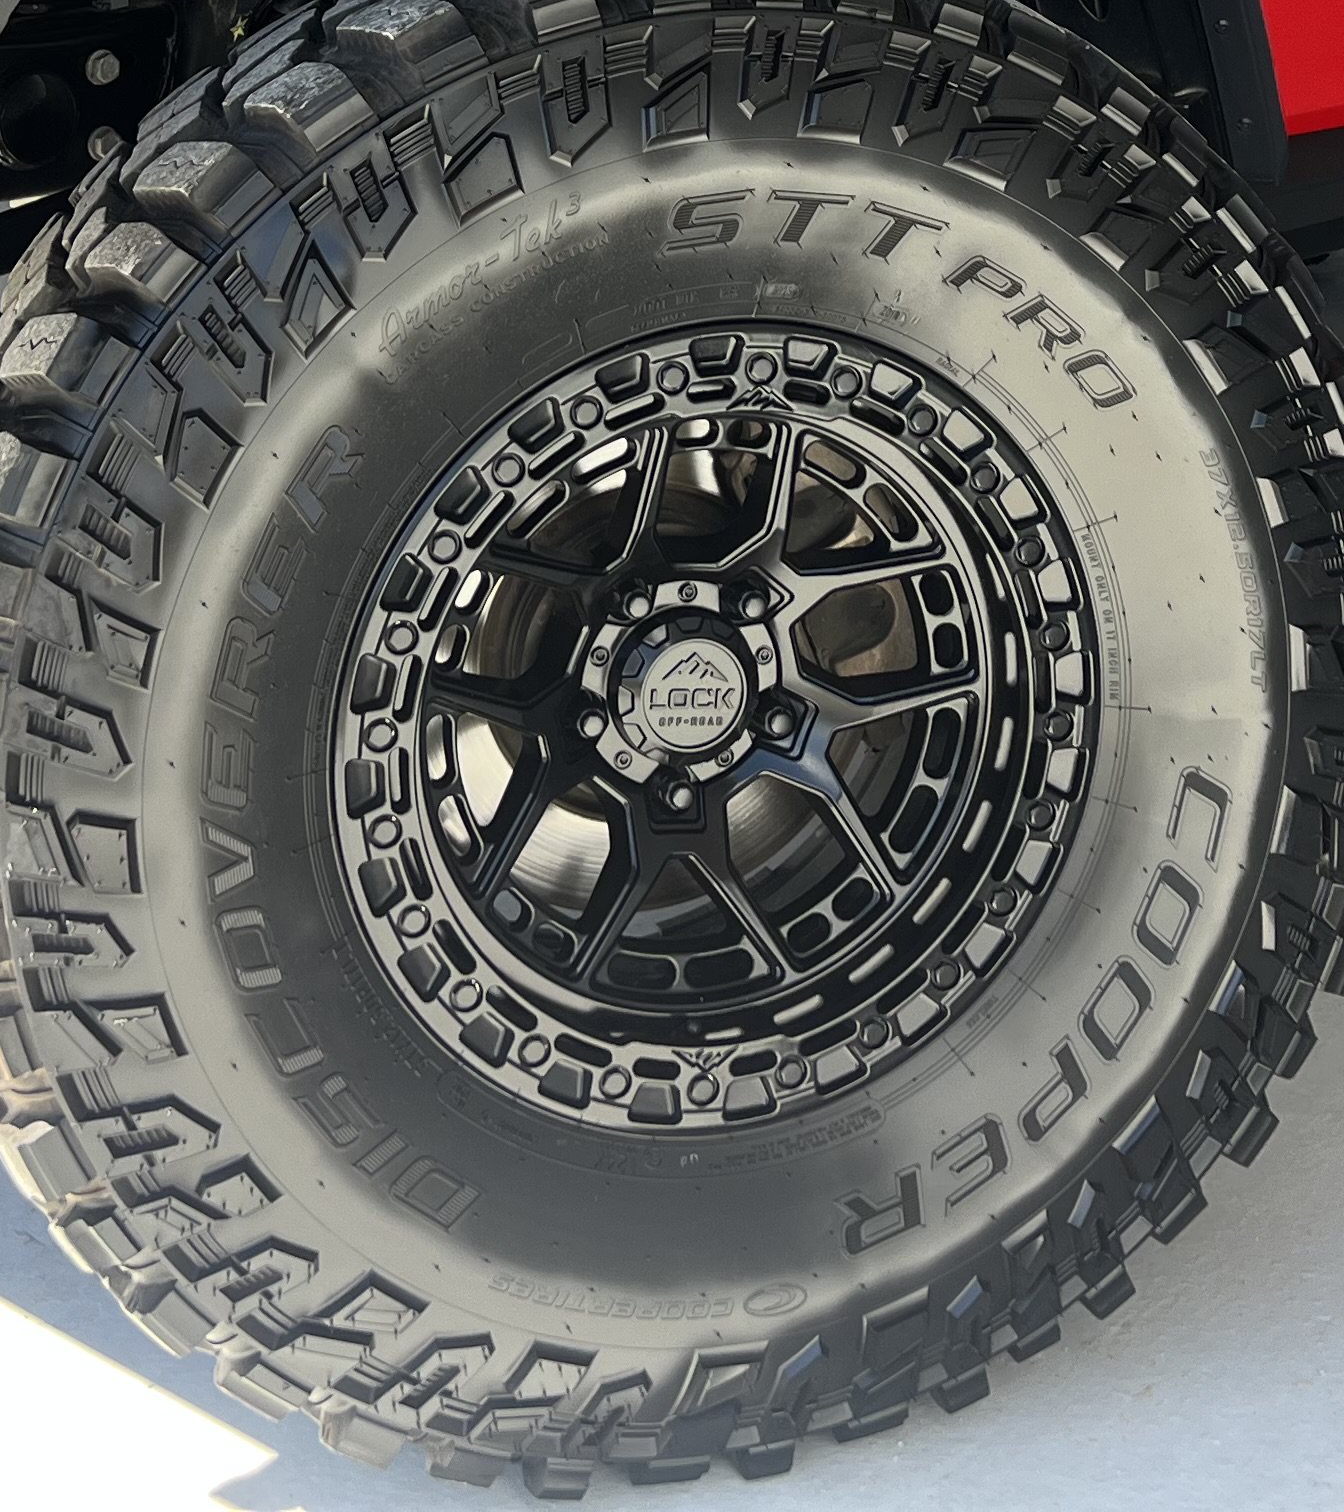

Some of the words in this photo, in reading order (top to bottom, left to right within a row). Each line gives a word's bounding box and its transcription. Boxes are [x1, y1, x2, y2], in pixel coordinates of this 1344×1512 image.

[200, 424, 481, 1231] DISCOVERER
[656, 187, 951, 265] STT
[942, 254, 1138, 412] PRO
[649, 688, 736, 710] LOCK
[839, 764, 1234, 1259] COOPER
